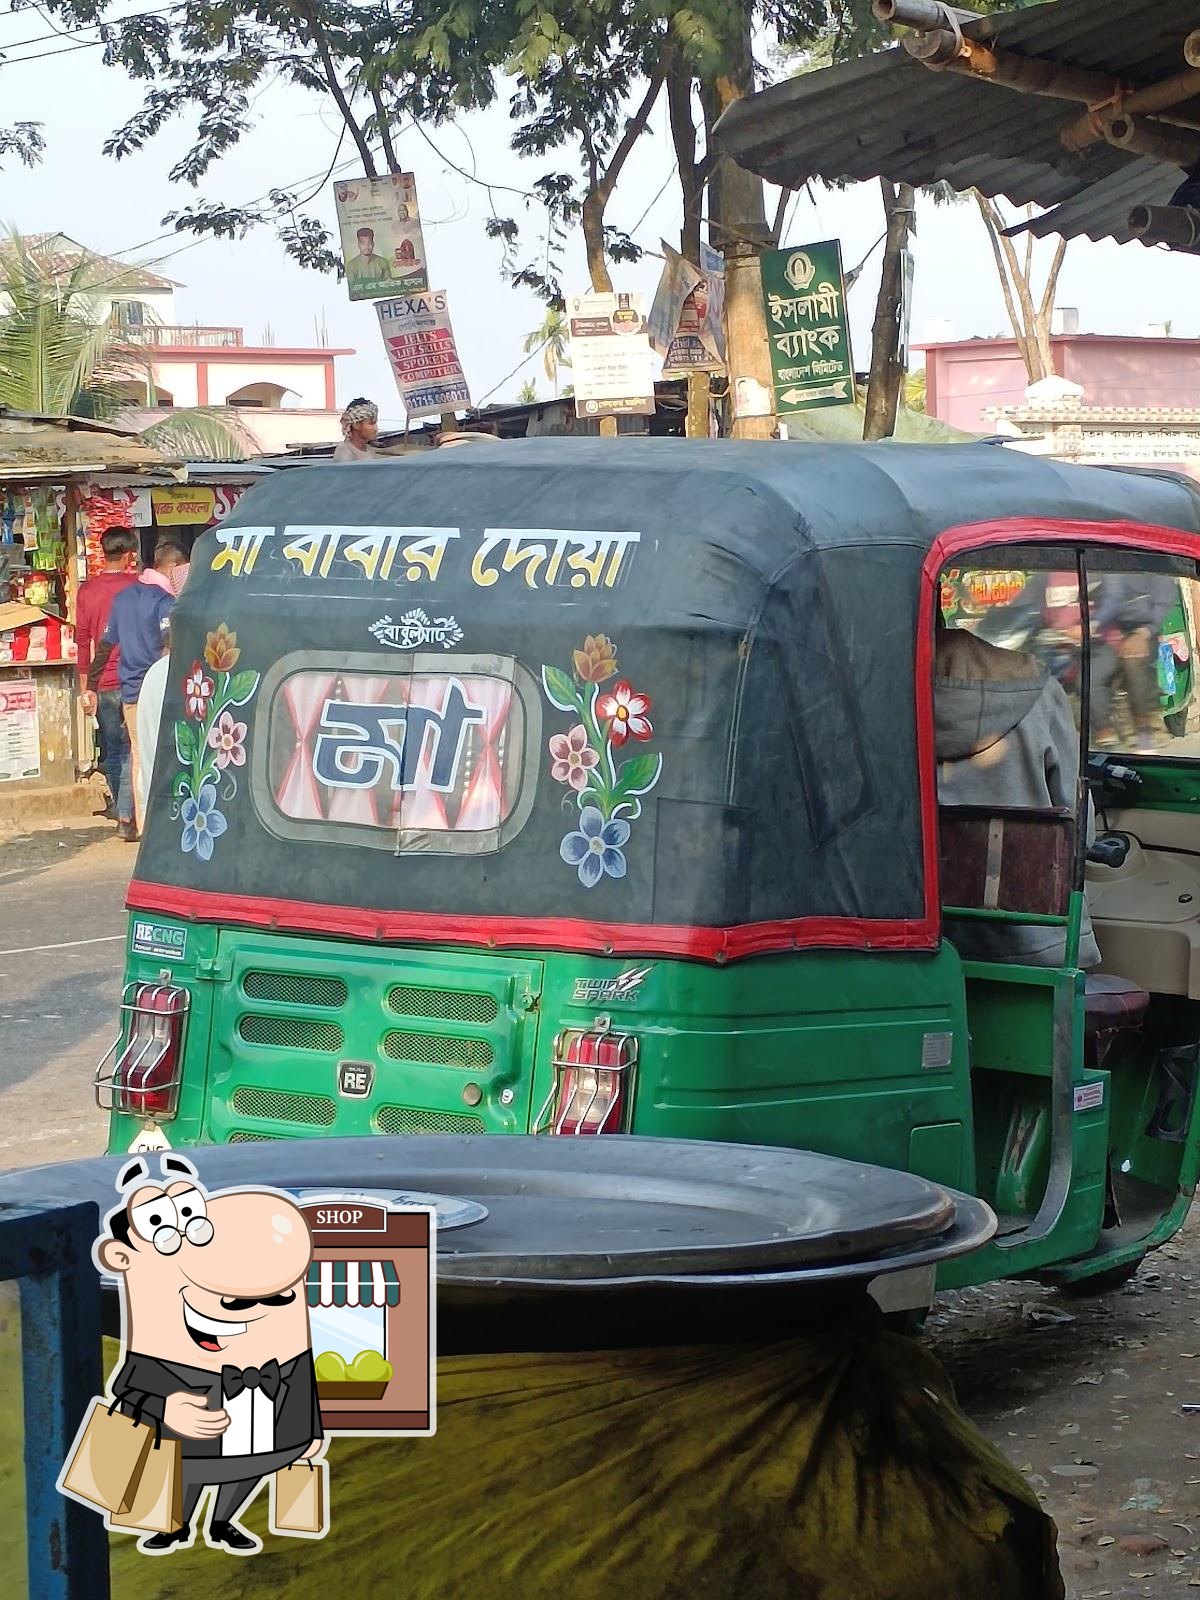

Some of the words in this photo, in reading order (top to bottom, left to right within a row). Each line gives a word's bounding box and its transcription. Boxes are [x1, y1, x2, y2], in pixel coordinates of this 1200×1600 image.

[380, 295, 446, 319] HEXA'S
[768, 282, 840, 329] ইসলামী
[403, 330, 438, 345] IELTS
[773, 325, 841, 358] ব্যাংক
[397, 346, 418, 359] LIFE
[418, 340, 454, 354] SKILLS
[403, 353, 450, 370] SPOKEN
[401, 365, 458, 381] COMPUTER
[211, 526, 276, 577] মা
[283, 525, 460, 582] বাবার
[471, 528, 641, 589] দোয়া
[573, 989, 641, 1002] SPARK
[343, 1072, 367, 1090] RE
